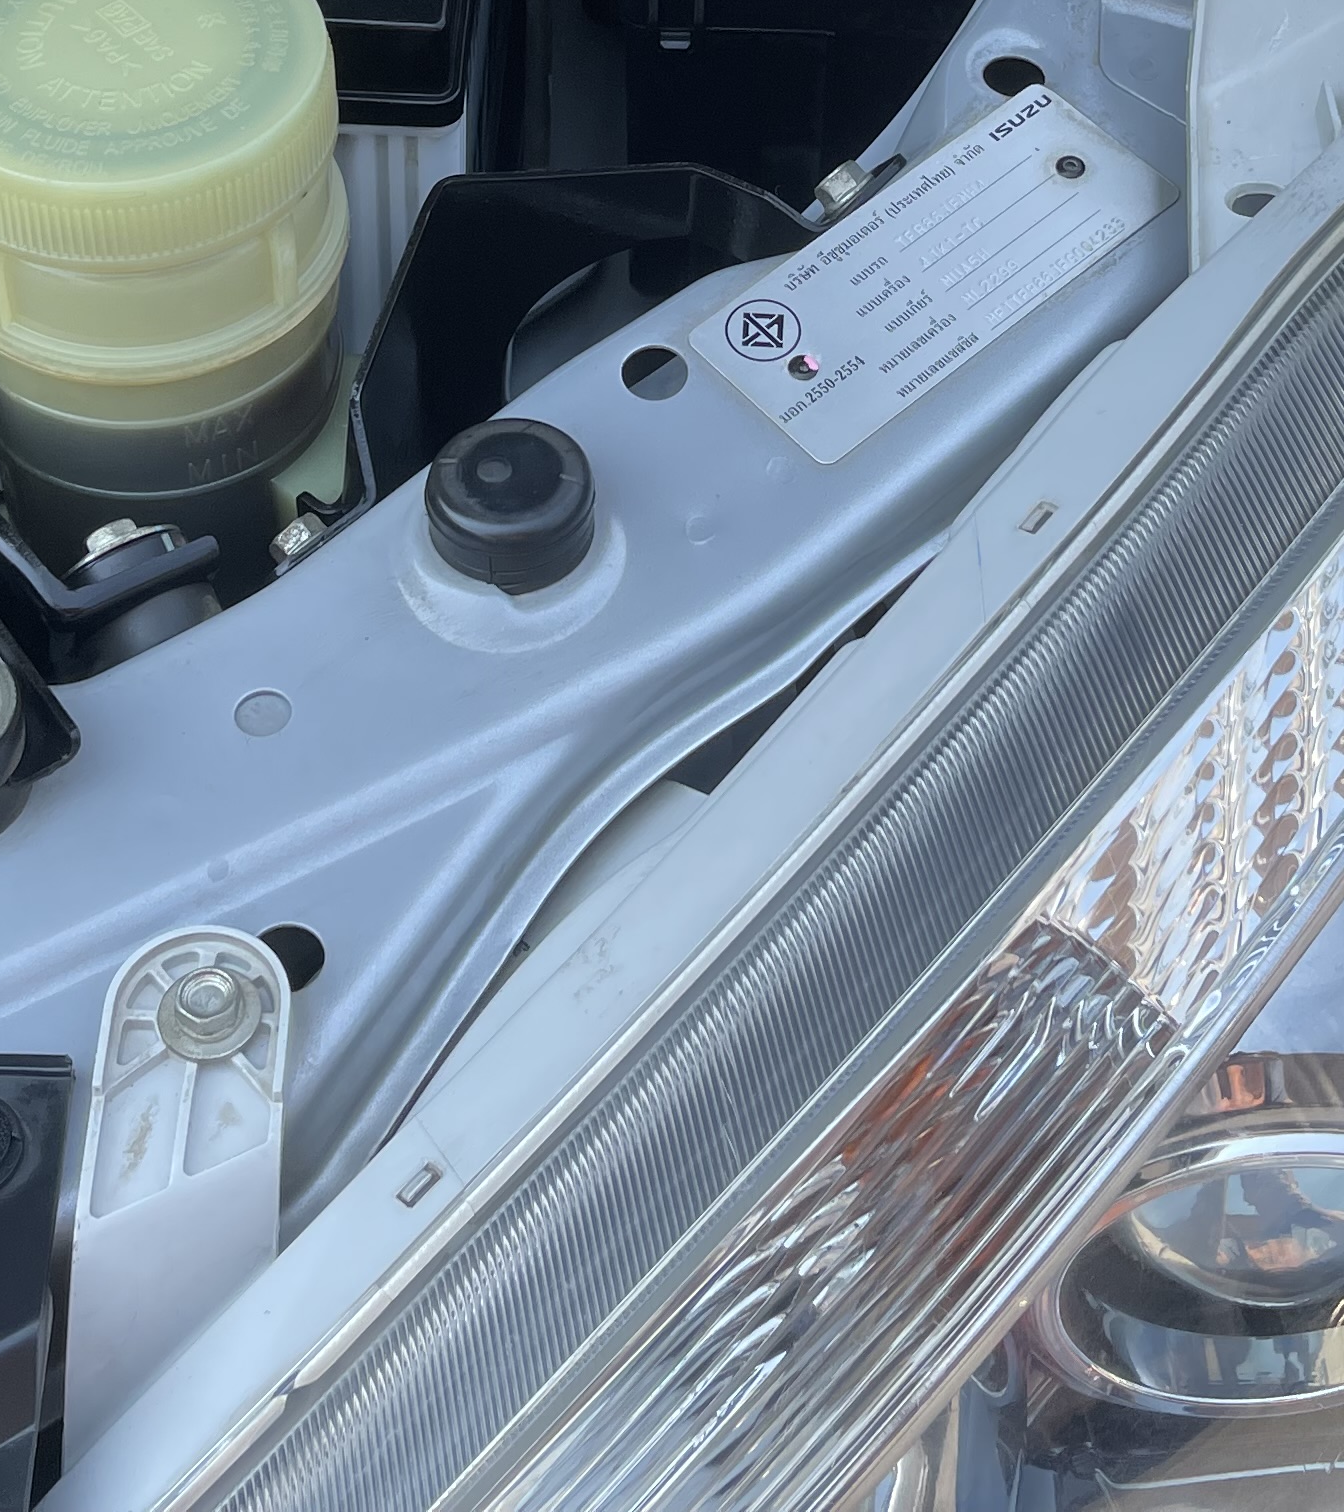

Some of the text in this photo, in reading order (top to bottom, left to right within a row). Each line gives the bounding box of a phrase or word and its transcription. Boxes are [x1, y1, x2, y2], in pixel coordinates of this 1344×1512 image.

[37, 60, 214, 111] ATTENTION
[220, 97, 251, 120] DE
[783, 90, 1052, 294] บริษัท อีซูซุมอเตอร์ (ประเทศไทย) จำกัด ISUZU
[849, 252, 888, 287] แบบรถ
[851, 267, 911, 319] แบบเครื่อง
[882, 290, 934, 334] แบบเกียร์
[874, 306, 957, 375] หมายเลขเครื่อง
[778, 352, 866, 426] มอก.2550-2554
